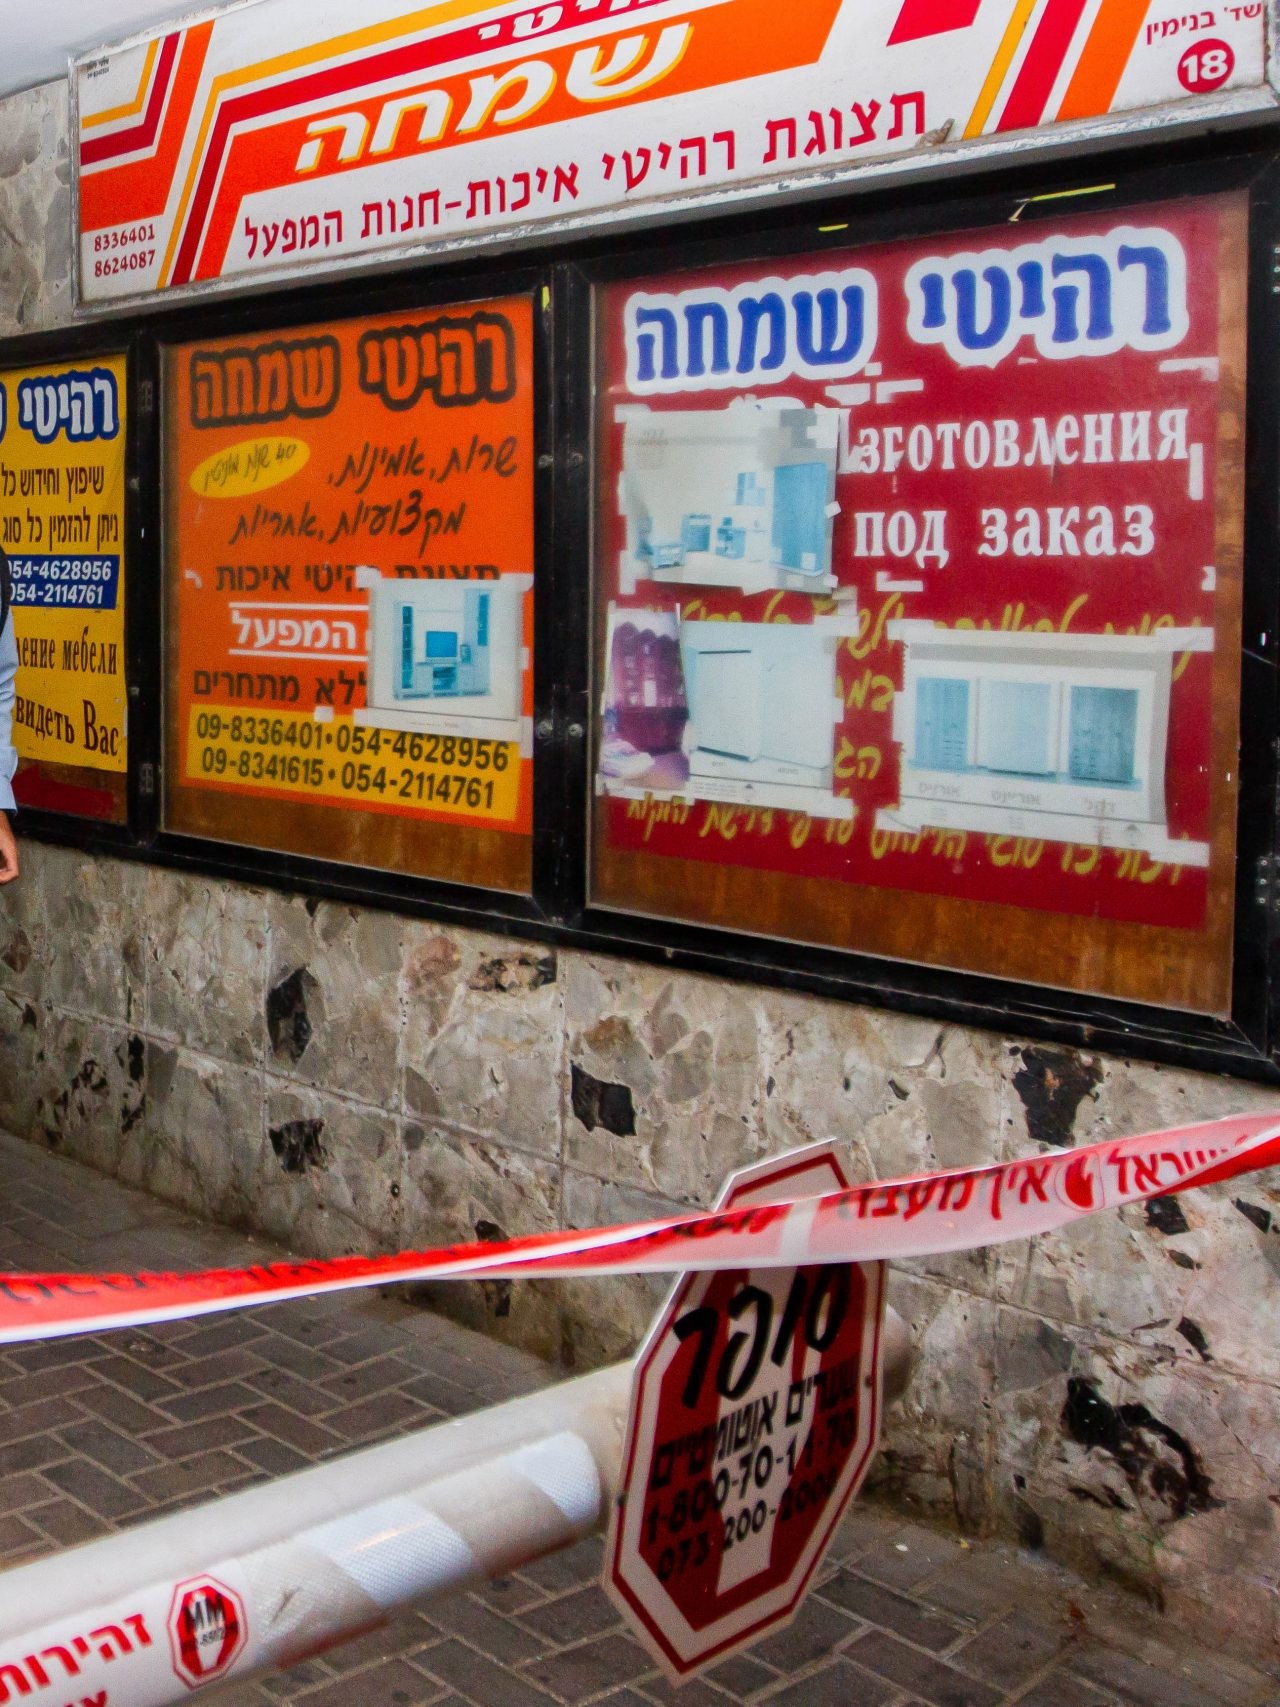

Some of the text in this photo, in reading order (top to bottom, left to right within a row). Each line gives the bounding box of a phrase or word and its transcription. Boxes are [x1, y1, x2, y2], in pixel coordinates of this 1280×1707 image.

[477, 0, 662, 40] יטי
[1146, 11, 1216, 45] בנימין
[1182, 49, 1228, 83] 18
[296, 22, 694, 173] שמחה
[763, 90, 927, 164] תצוגת
[602, 130, 735, 193] רהיטי
[93, 229, 155, 252] 8336401
[245, 213, 343, 259] המפעל
[93, 255, 155, 278] 8624087
[632, 241, 1175, 384] רהיטי שמחה
[192, 316, 513, 426] רהיטי שמחה
[21, 375, 116, 438] רהיטי
[1, 463, 17, 496] כל
[21, 467, 60, 495] וחידוש
[66, 465, 104, 503] שיפוץ
[3, 515, 21, 543] סוג
[27, 508, 43, 543] כל
[49, 507, 91, 552] להזמין
[97, 513, 119, 551] ניתן
[853, 504, 1156, 568] под заказ
[215, 565, 292, 593] איכות
[62, 625, 117, 675] мебели
[231, 609, 356, 650] המפעל
[194, 669, 300, 703] מתחרים
[16, 696, 119, 757] видеть Вас
[196, 712, 510, 772] 09-8336401 054-4628956
[202, 746, 495, 809] 09-8341615 054-2114761
[990, 1163, 1052, 1221] אין
[673, 1262, 853, 1409] סופר
